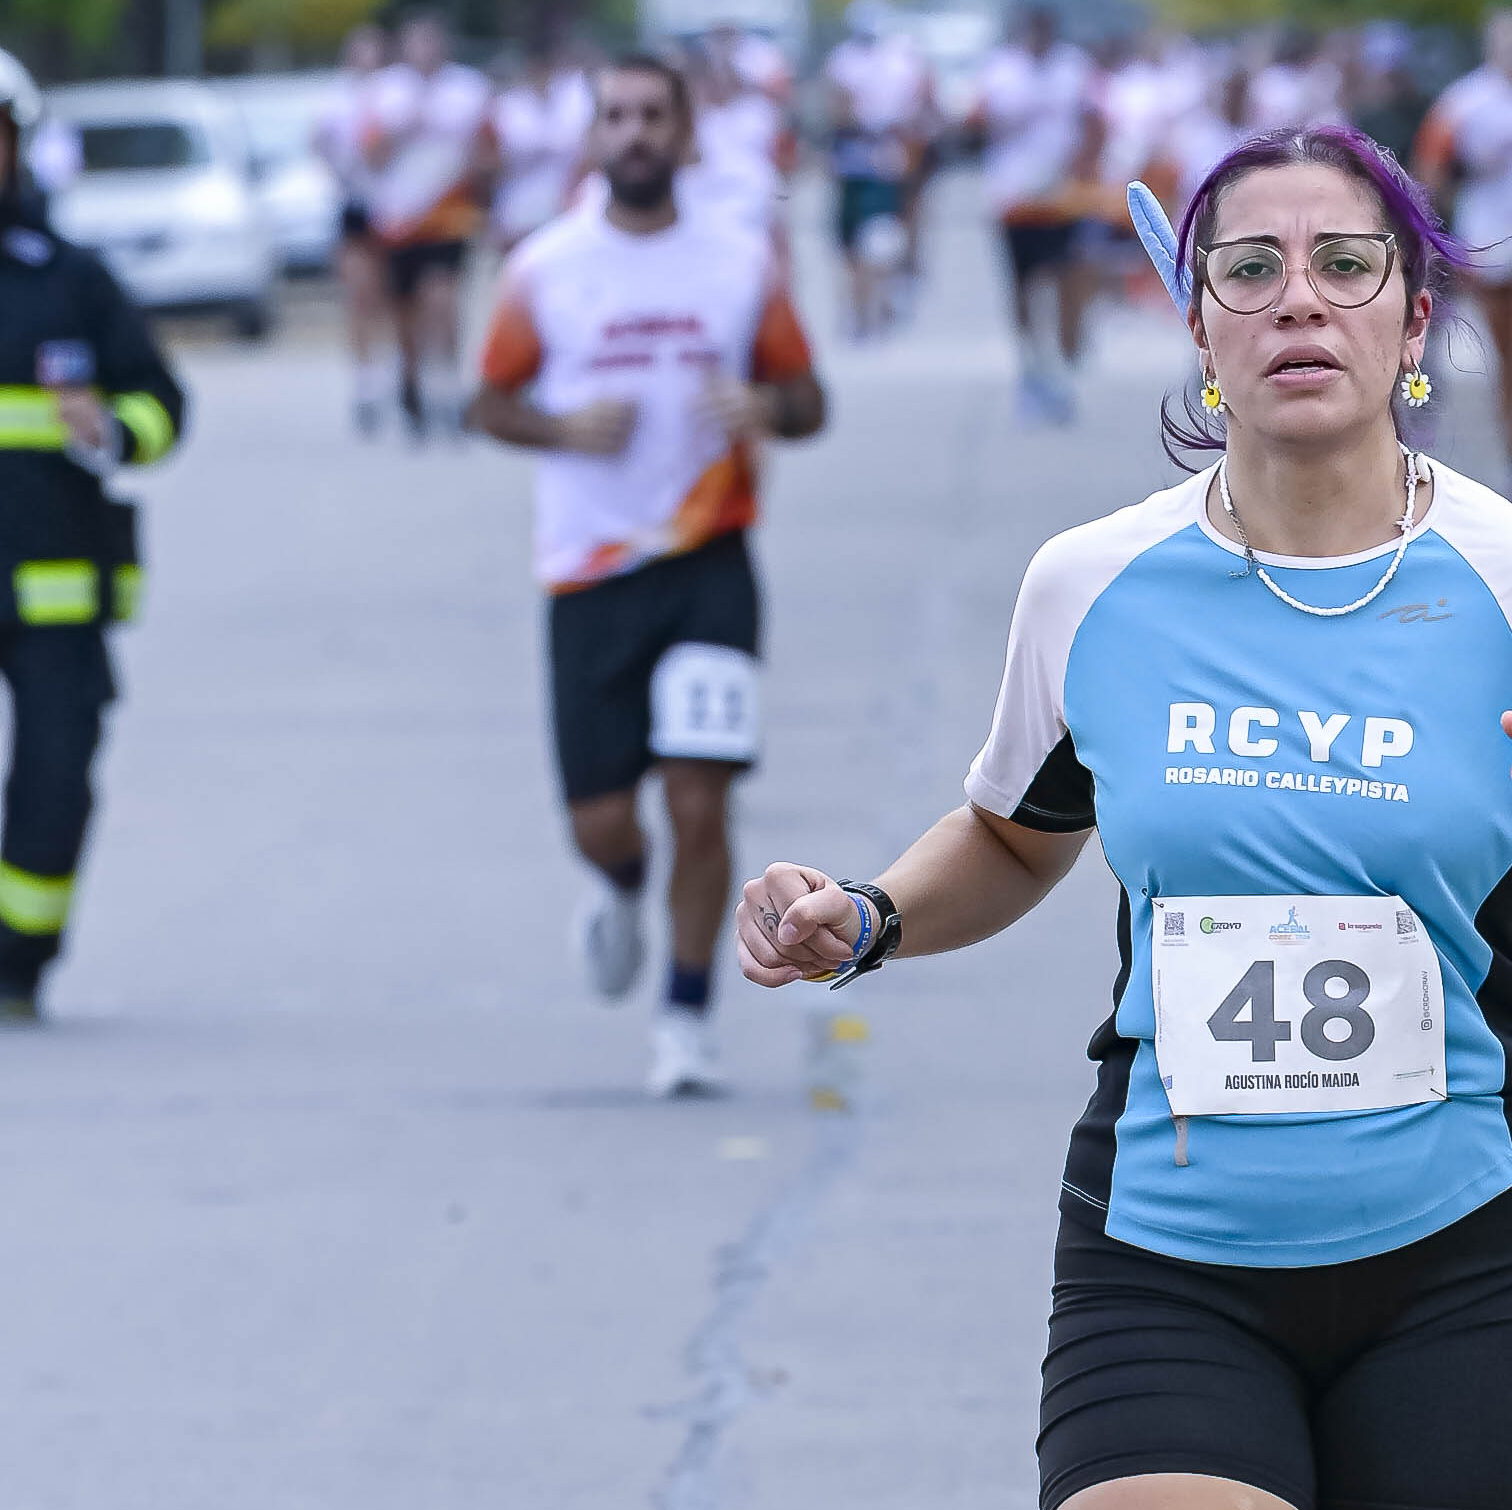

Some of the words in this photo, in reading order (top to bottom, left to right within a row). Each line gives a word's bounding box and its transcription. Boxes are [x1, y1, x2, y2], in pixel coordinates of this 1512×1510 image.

[1166, 702, 1414, 767] RCYP
[1165, 767, 1259, 787] ROSARIO
[1265, 771, 1410, 803] CALLEYPISTA
[1207, 960, 1375, 1062] 48
[1225, 1075, 1281, 1089] AGUSTINA
[1285, 1071, 1318, 1088] ROCÍO
[1322, 1073, 1360, 1087] MAIDA
